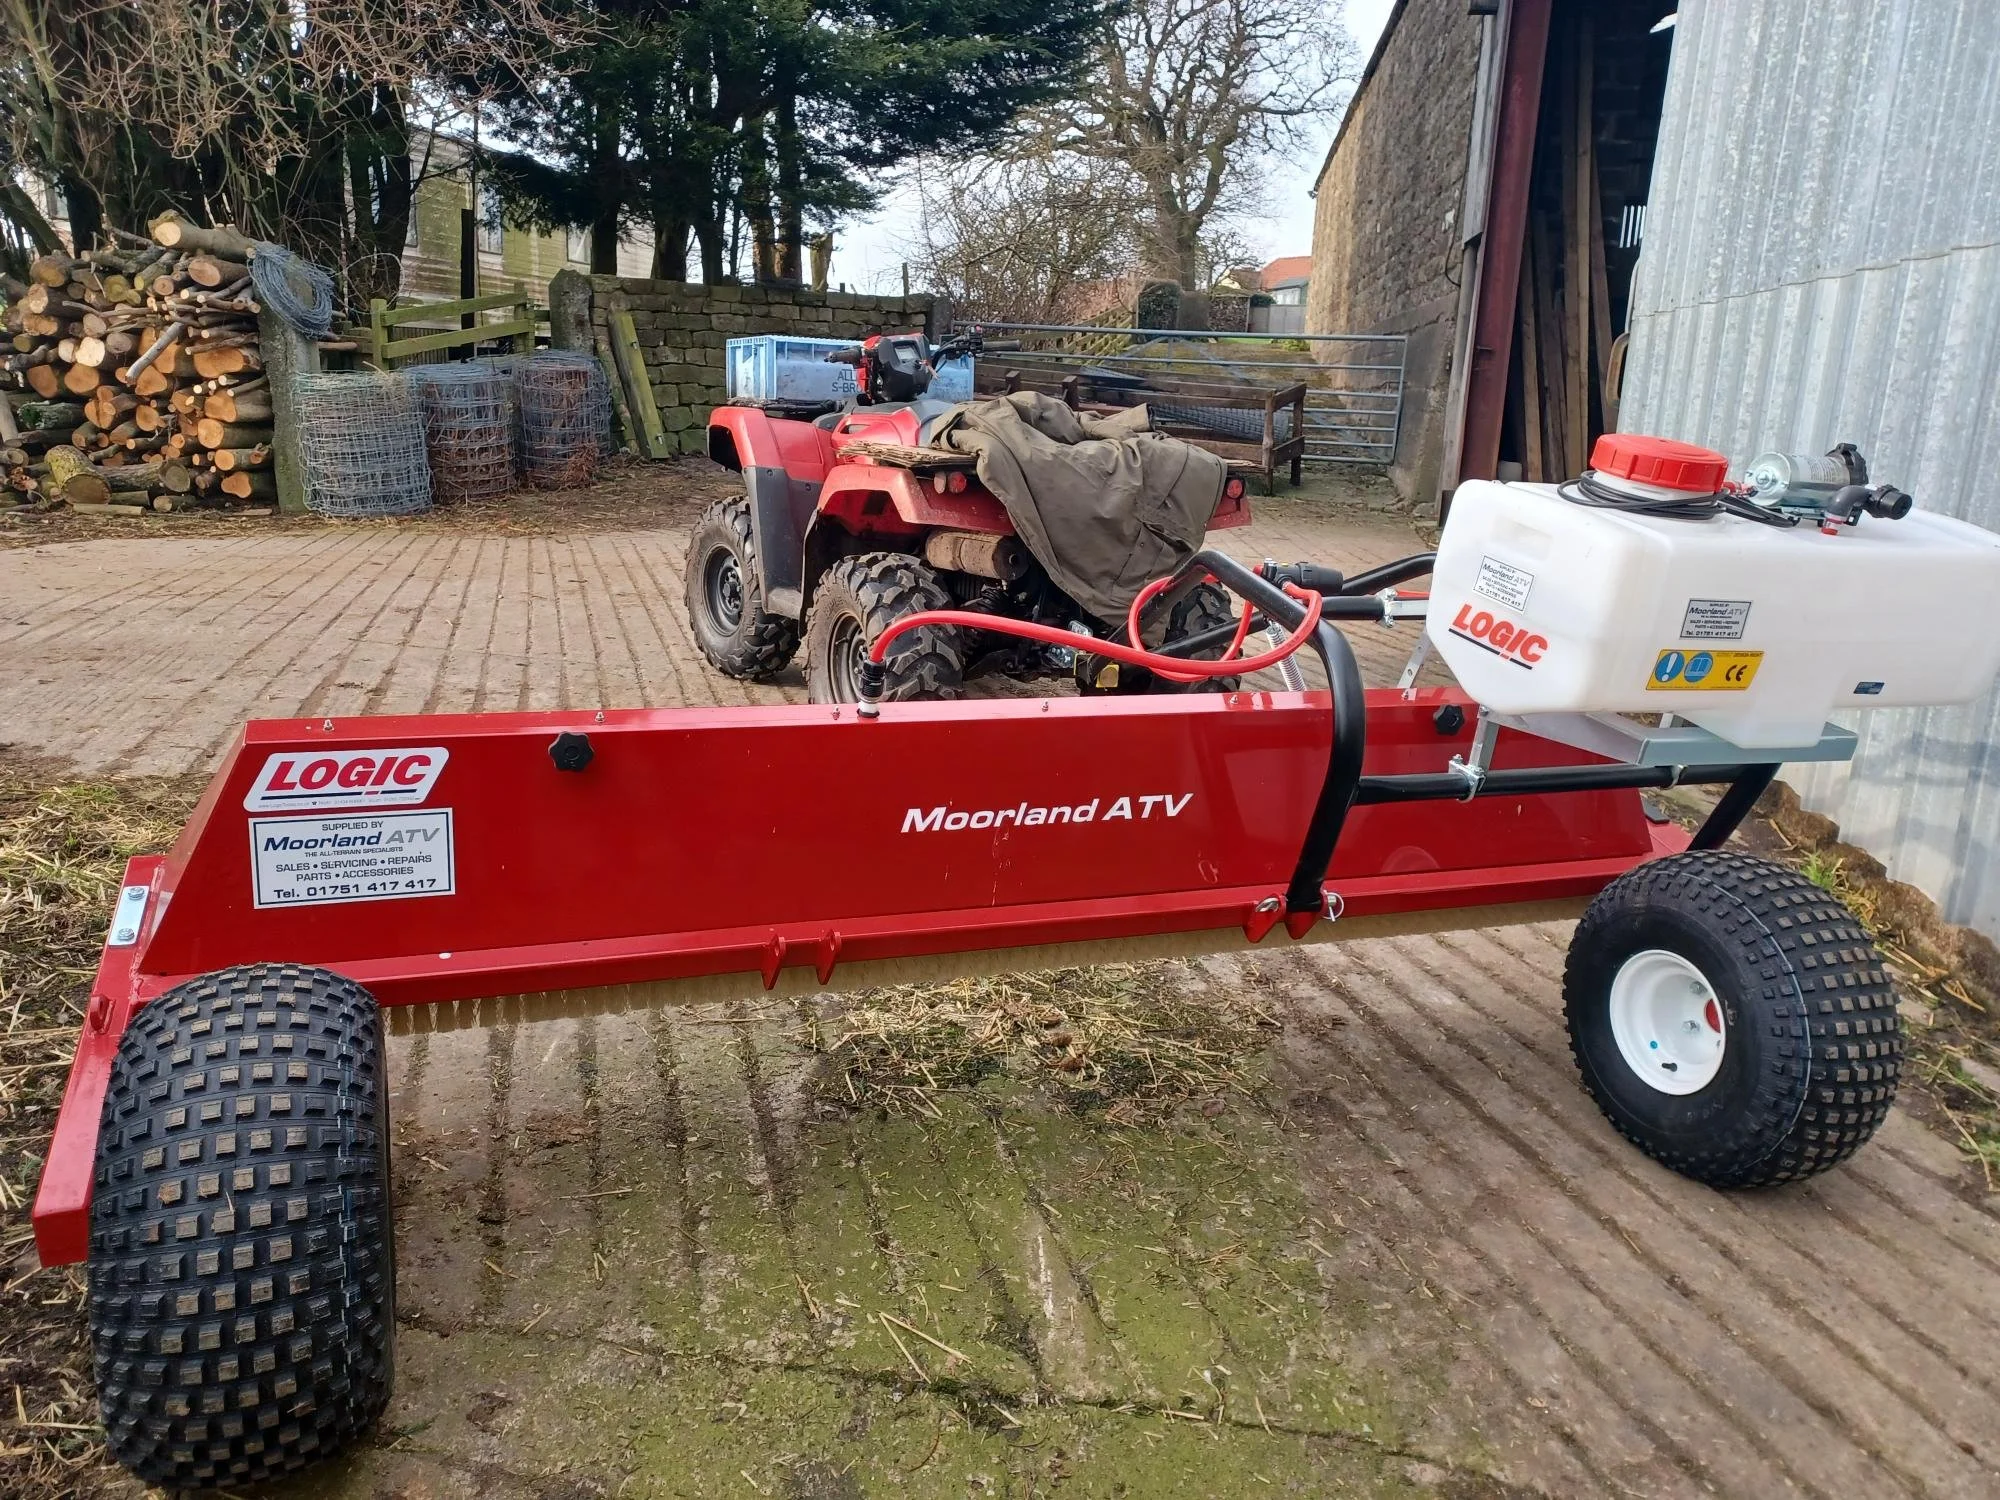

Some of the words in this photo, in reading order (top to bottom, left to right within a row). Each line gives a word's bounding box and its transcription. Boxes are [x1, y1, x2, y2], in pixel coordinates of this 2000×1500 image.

[1483, 563, 1514, 580] Moorland
[1688, 607, 1728, 615] Moorland
[1452, 603, 1548, 663] LOGIC
[1725, 664, 1748, 681] CE
[265, 754, 432, 792] LOGIC
[900, 798, 1100, 833] Moorland
[1102, 793, 1194, 821] ATV
[321, 821, 368, 831] SUPPLIED
[371, 821, 384, 829] BY
[263, 831, 382, 851] Moorland
[385, 828, 440, 844] ATV
[363, 846, 403, 854] SPECIALISTS
[276, 862, 310, 872] SALES
[320, 858, 377, 870] SERVICING
[387, 855, 432, 865] REPAIRS
[296, 872, 332, 882] PARTS
[342, 866, 414, 879] ACCESSORIES
[273, 889, 300, 898] Tel.
[307, 884, 360, 896] 01751
[367, 881, 399, 891] 417
[405, 878, 437, 889] 417
